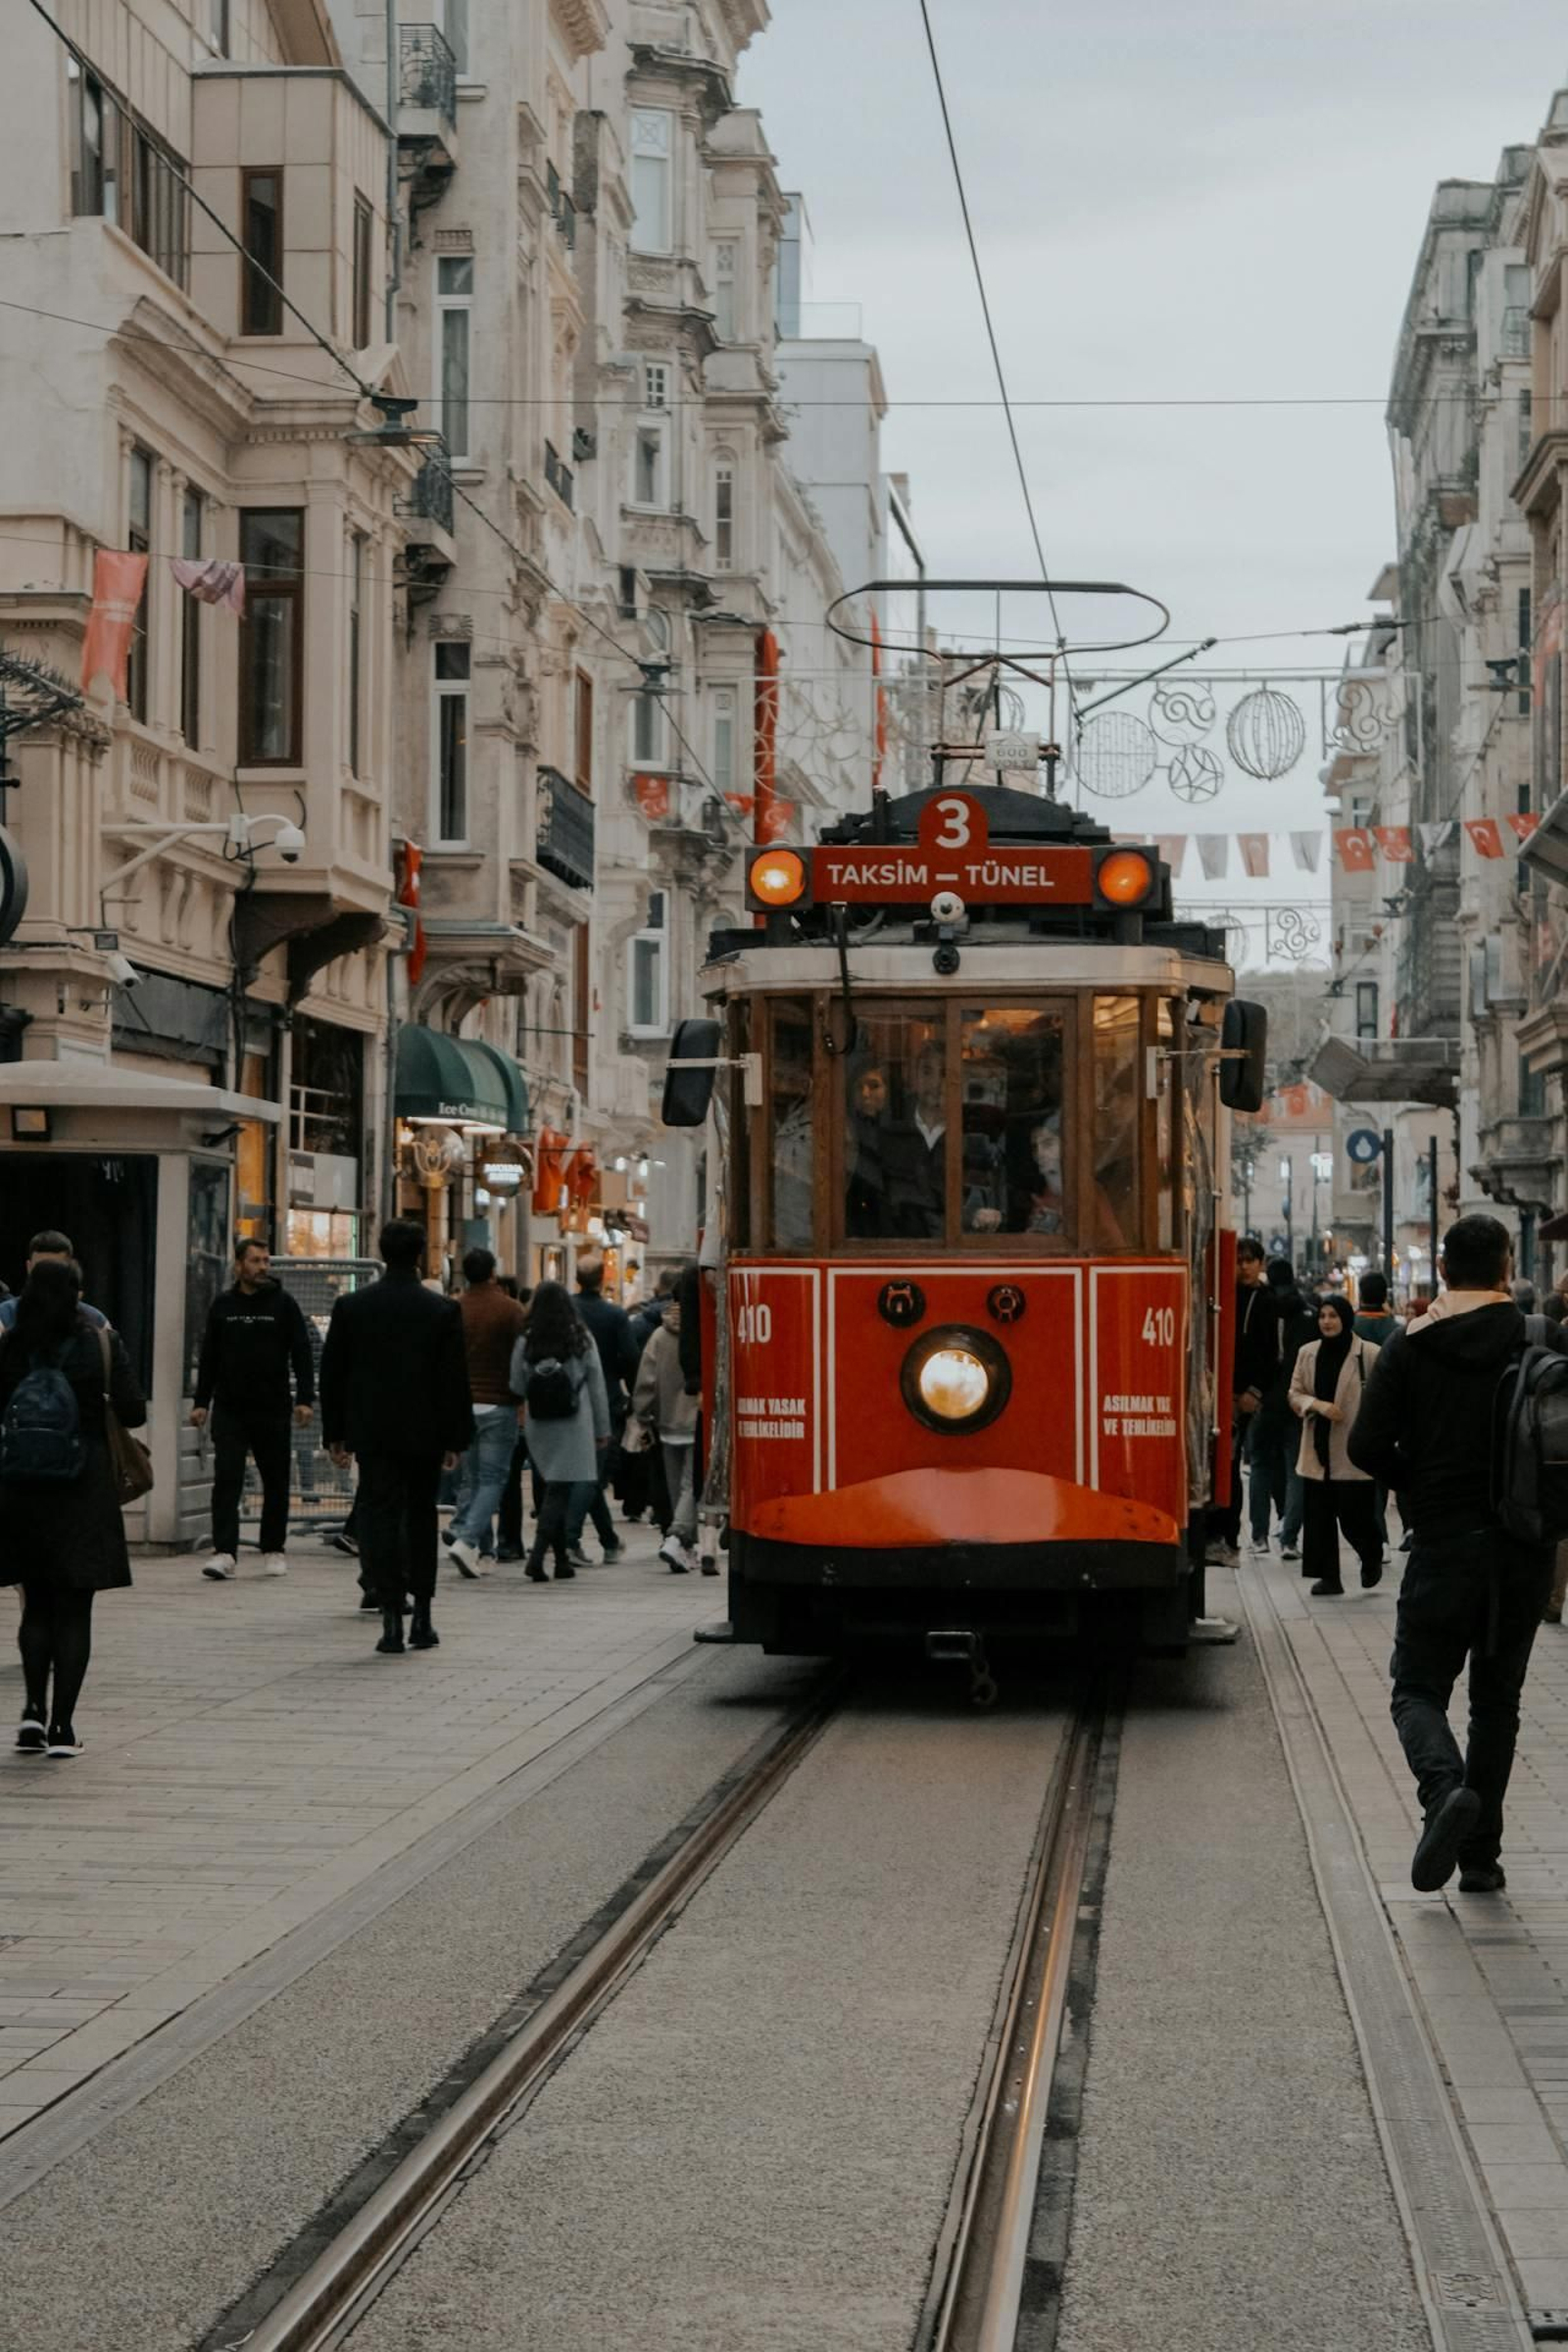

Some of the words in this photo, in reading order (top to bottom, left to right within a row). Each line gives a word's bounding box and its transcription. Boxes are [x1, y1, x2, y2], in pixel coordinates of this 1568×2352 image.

[935, 799, 971, 849] 3
[827, 859, 928, 885] TAKSİM
[964, 860, 1055, 886] TÜNEL
[438, 1102, 458, 1116] Ice
[737, 1303, 772, 1344] 410
[1142, 1306, 1175, 1347] 410
[767, 1398, 806, 1416] YASAK
[1103, 1395, 1154, 1412] ASILMAK
[1103, 1417, 1118, 1436] VE
